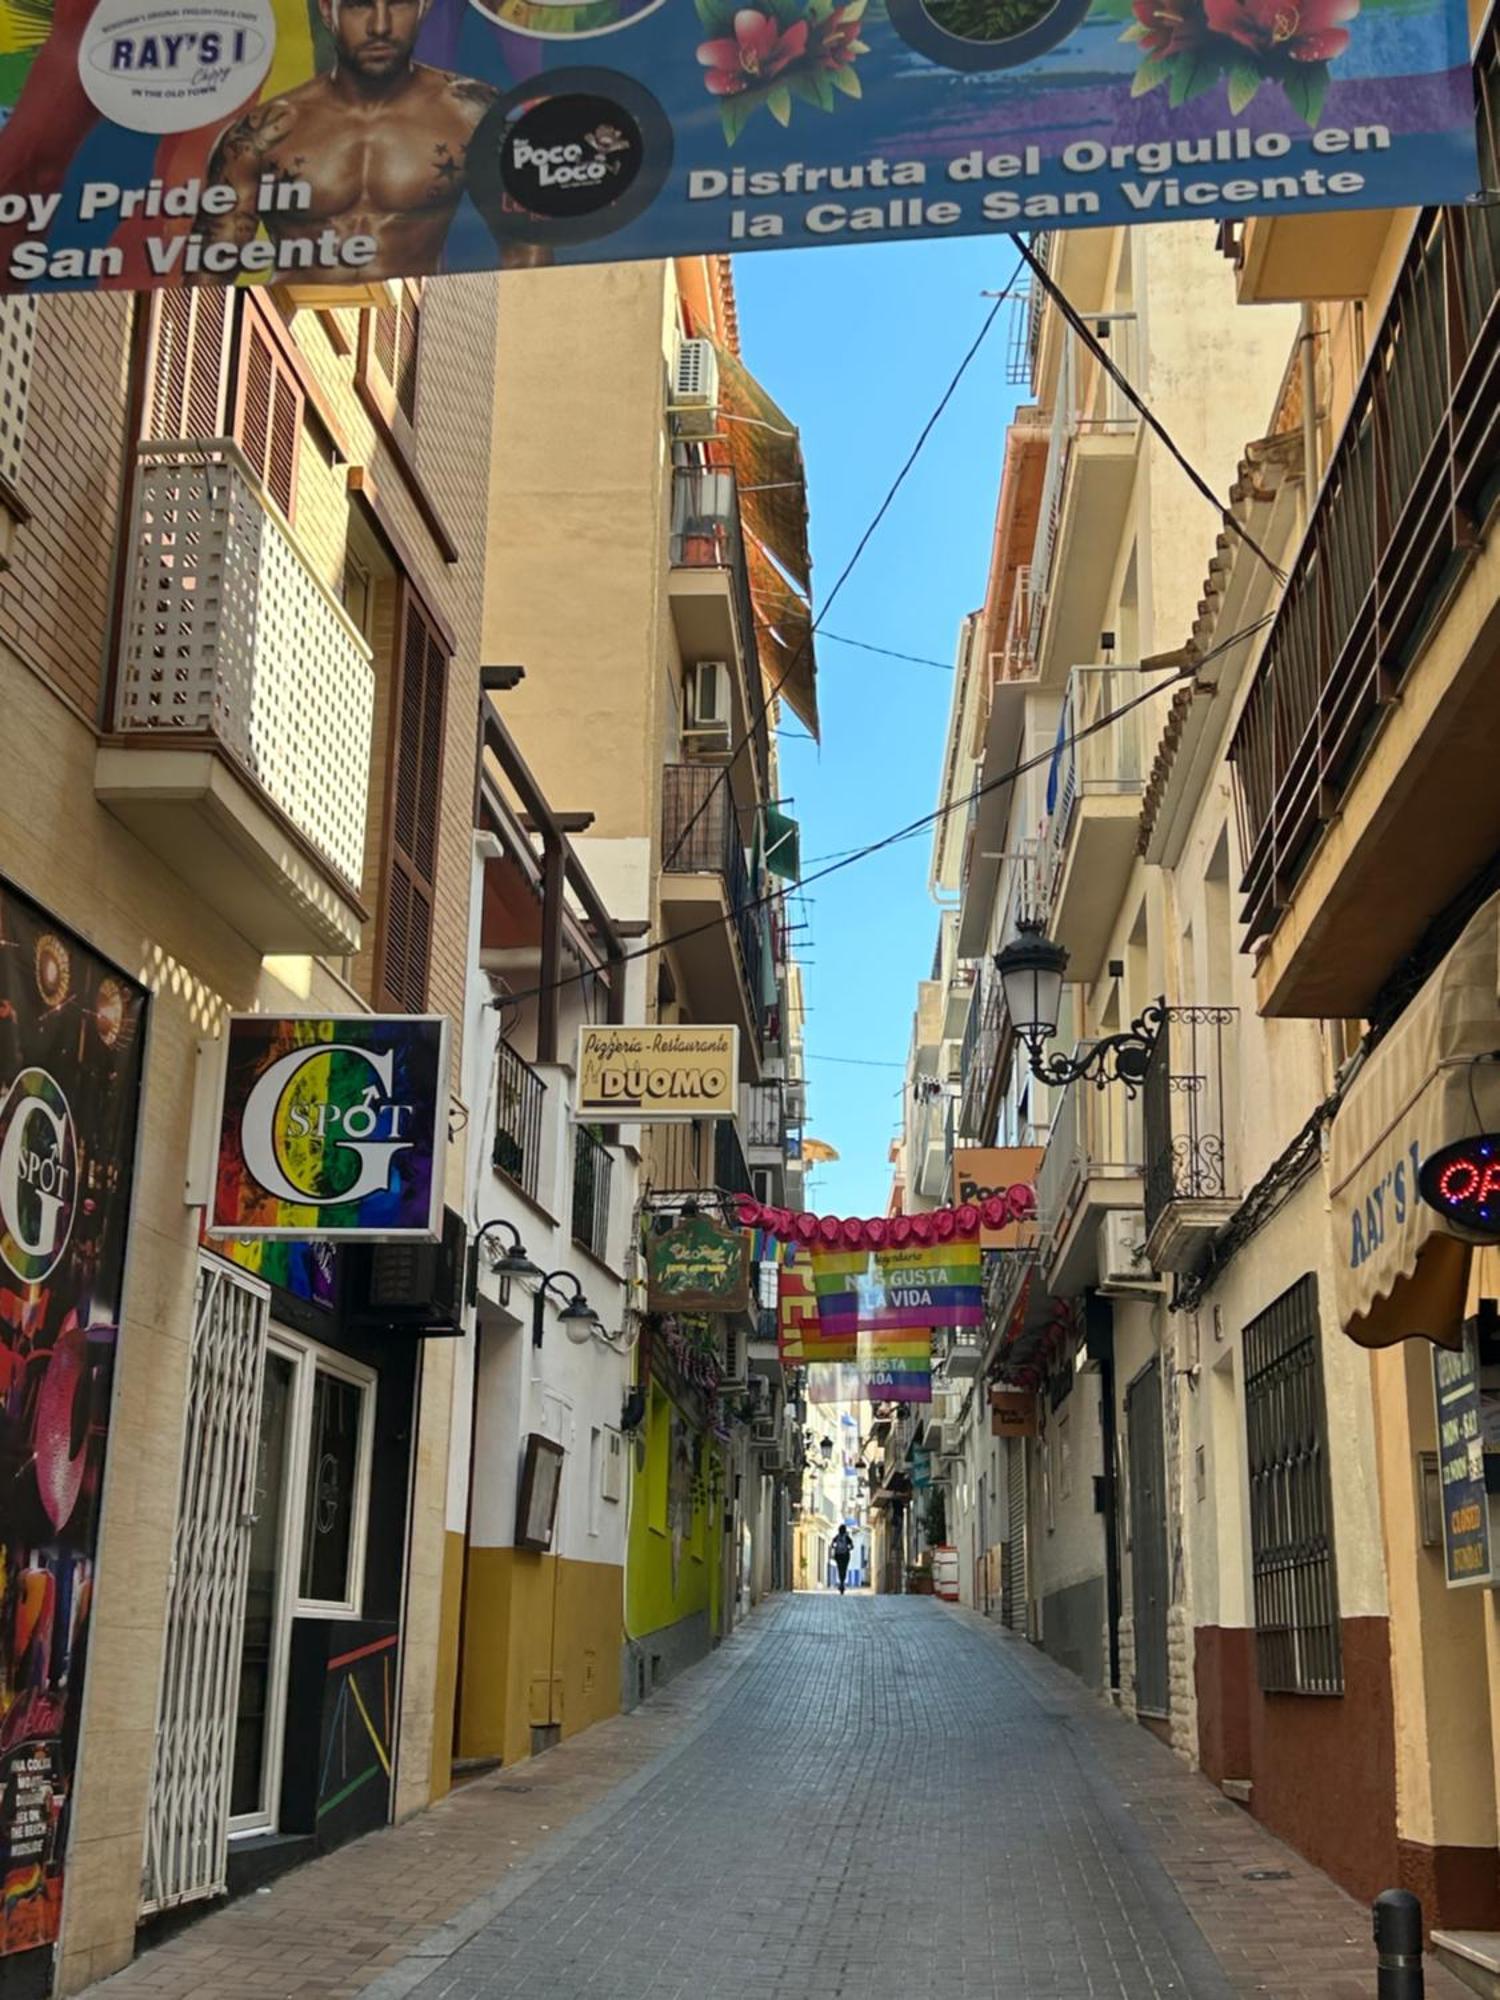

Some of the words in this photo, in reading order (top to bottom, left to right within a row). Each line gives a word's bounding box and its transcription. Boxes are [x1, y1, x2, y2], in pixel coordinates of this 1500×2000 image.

[111, 33, 221, 70] RAY'S
[144, 89, 162, 98] THE
[164, 89, 185, 98] OLD
[187, 86, 217, 97] TOWN
[688, 161, 926, 200] Disfruta
[948, 150, 1041, 181] del
[1063, 128, 1291, 173] Orgullo
[1313, 124, 1391, 153] en
[80, 178, 238, 221] Pride
[258, 174, 312, 212] in
[731, 210, 784, 239] la
[805, 198, 961, 234] Calle
[982, 190, 1099, 221] San
[1121, 169, 1365, 210] Vicente
[9, 241, 123, 280] San
[147, 229, 378, 274] Vicente
[601, 1067, 727, 1098] DUOMO
[241, 1044, 414, 1205] G
[287, 1086, 414, 1139] SPOT
[19, 1145, 69, 1199] SPOT
[1351, 1159, 1405, 1269] RAY'S
[890, 1268, 949, 1287] GUSTA
[892, 1289, 933, 1307] VIDA
